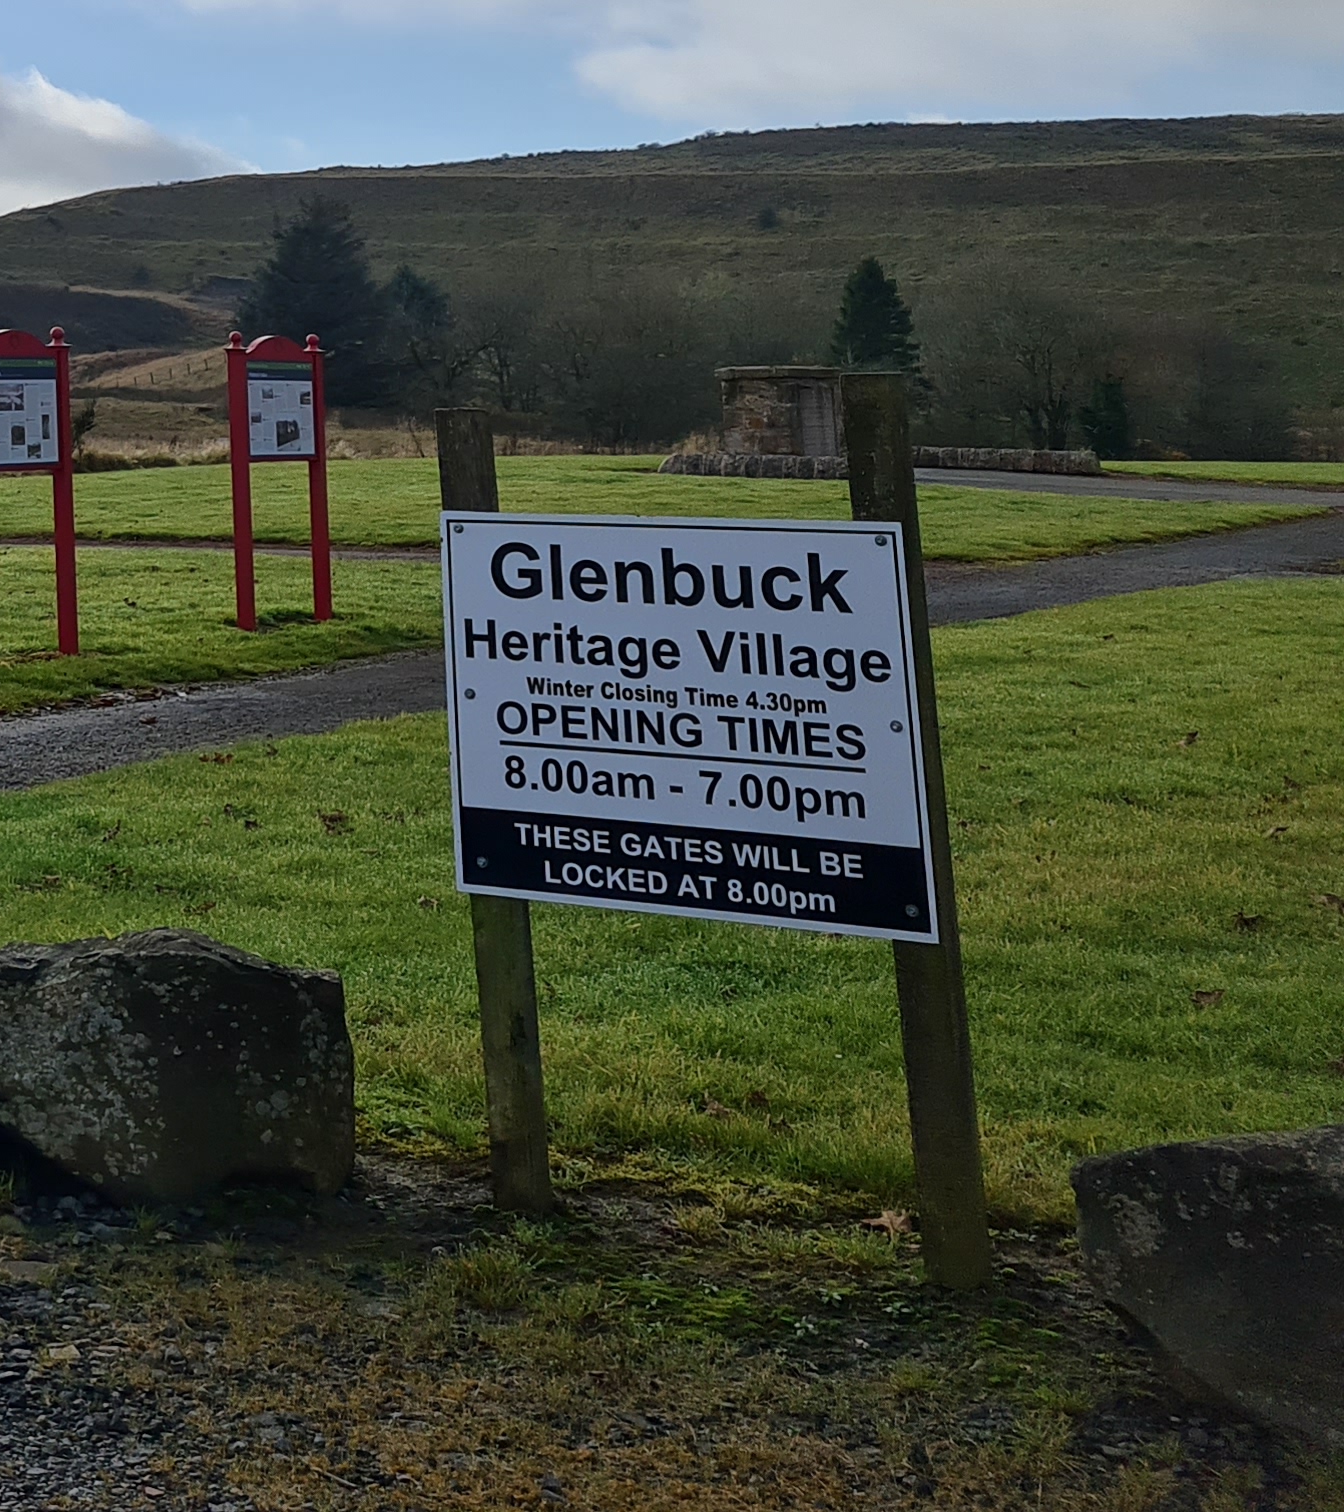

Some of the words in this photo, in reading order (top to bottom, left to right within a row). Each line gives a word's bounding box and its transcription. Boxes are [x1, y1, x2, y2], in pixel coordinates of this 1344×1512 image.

[490, 541, 853, 614] Glenbuck
[463, 618, 680, 679] Heritage
[697, 629, 892, 692] Village
[526, 677, 594, 699] Winter
[601, 682, 678, 708] Closing
[684, 688, 739, 708] Time
[745, 691, 827, 716] 4.30pm
[496, 701, 703, 748] OPENING
[717, 715, 866, 761] TIMES
[504, 755, 655, 800] 8.00am
[699, 770, 866, 822] 7.00pm
[514, 823, 610, 854] THESE
[620, 833, 723, 865] GATES
[731, 842, 810, 873] WILL
[819, 851, 863, 879] BE
[544, 860, 668, 894] LOCKED
[677, 874, 717, 901] AT
[727, 880, 836, 915] 8.00pm
